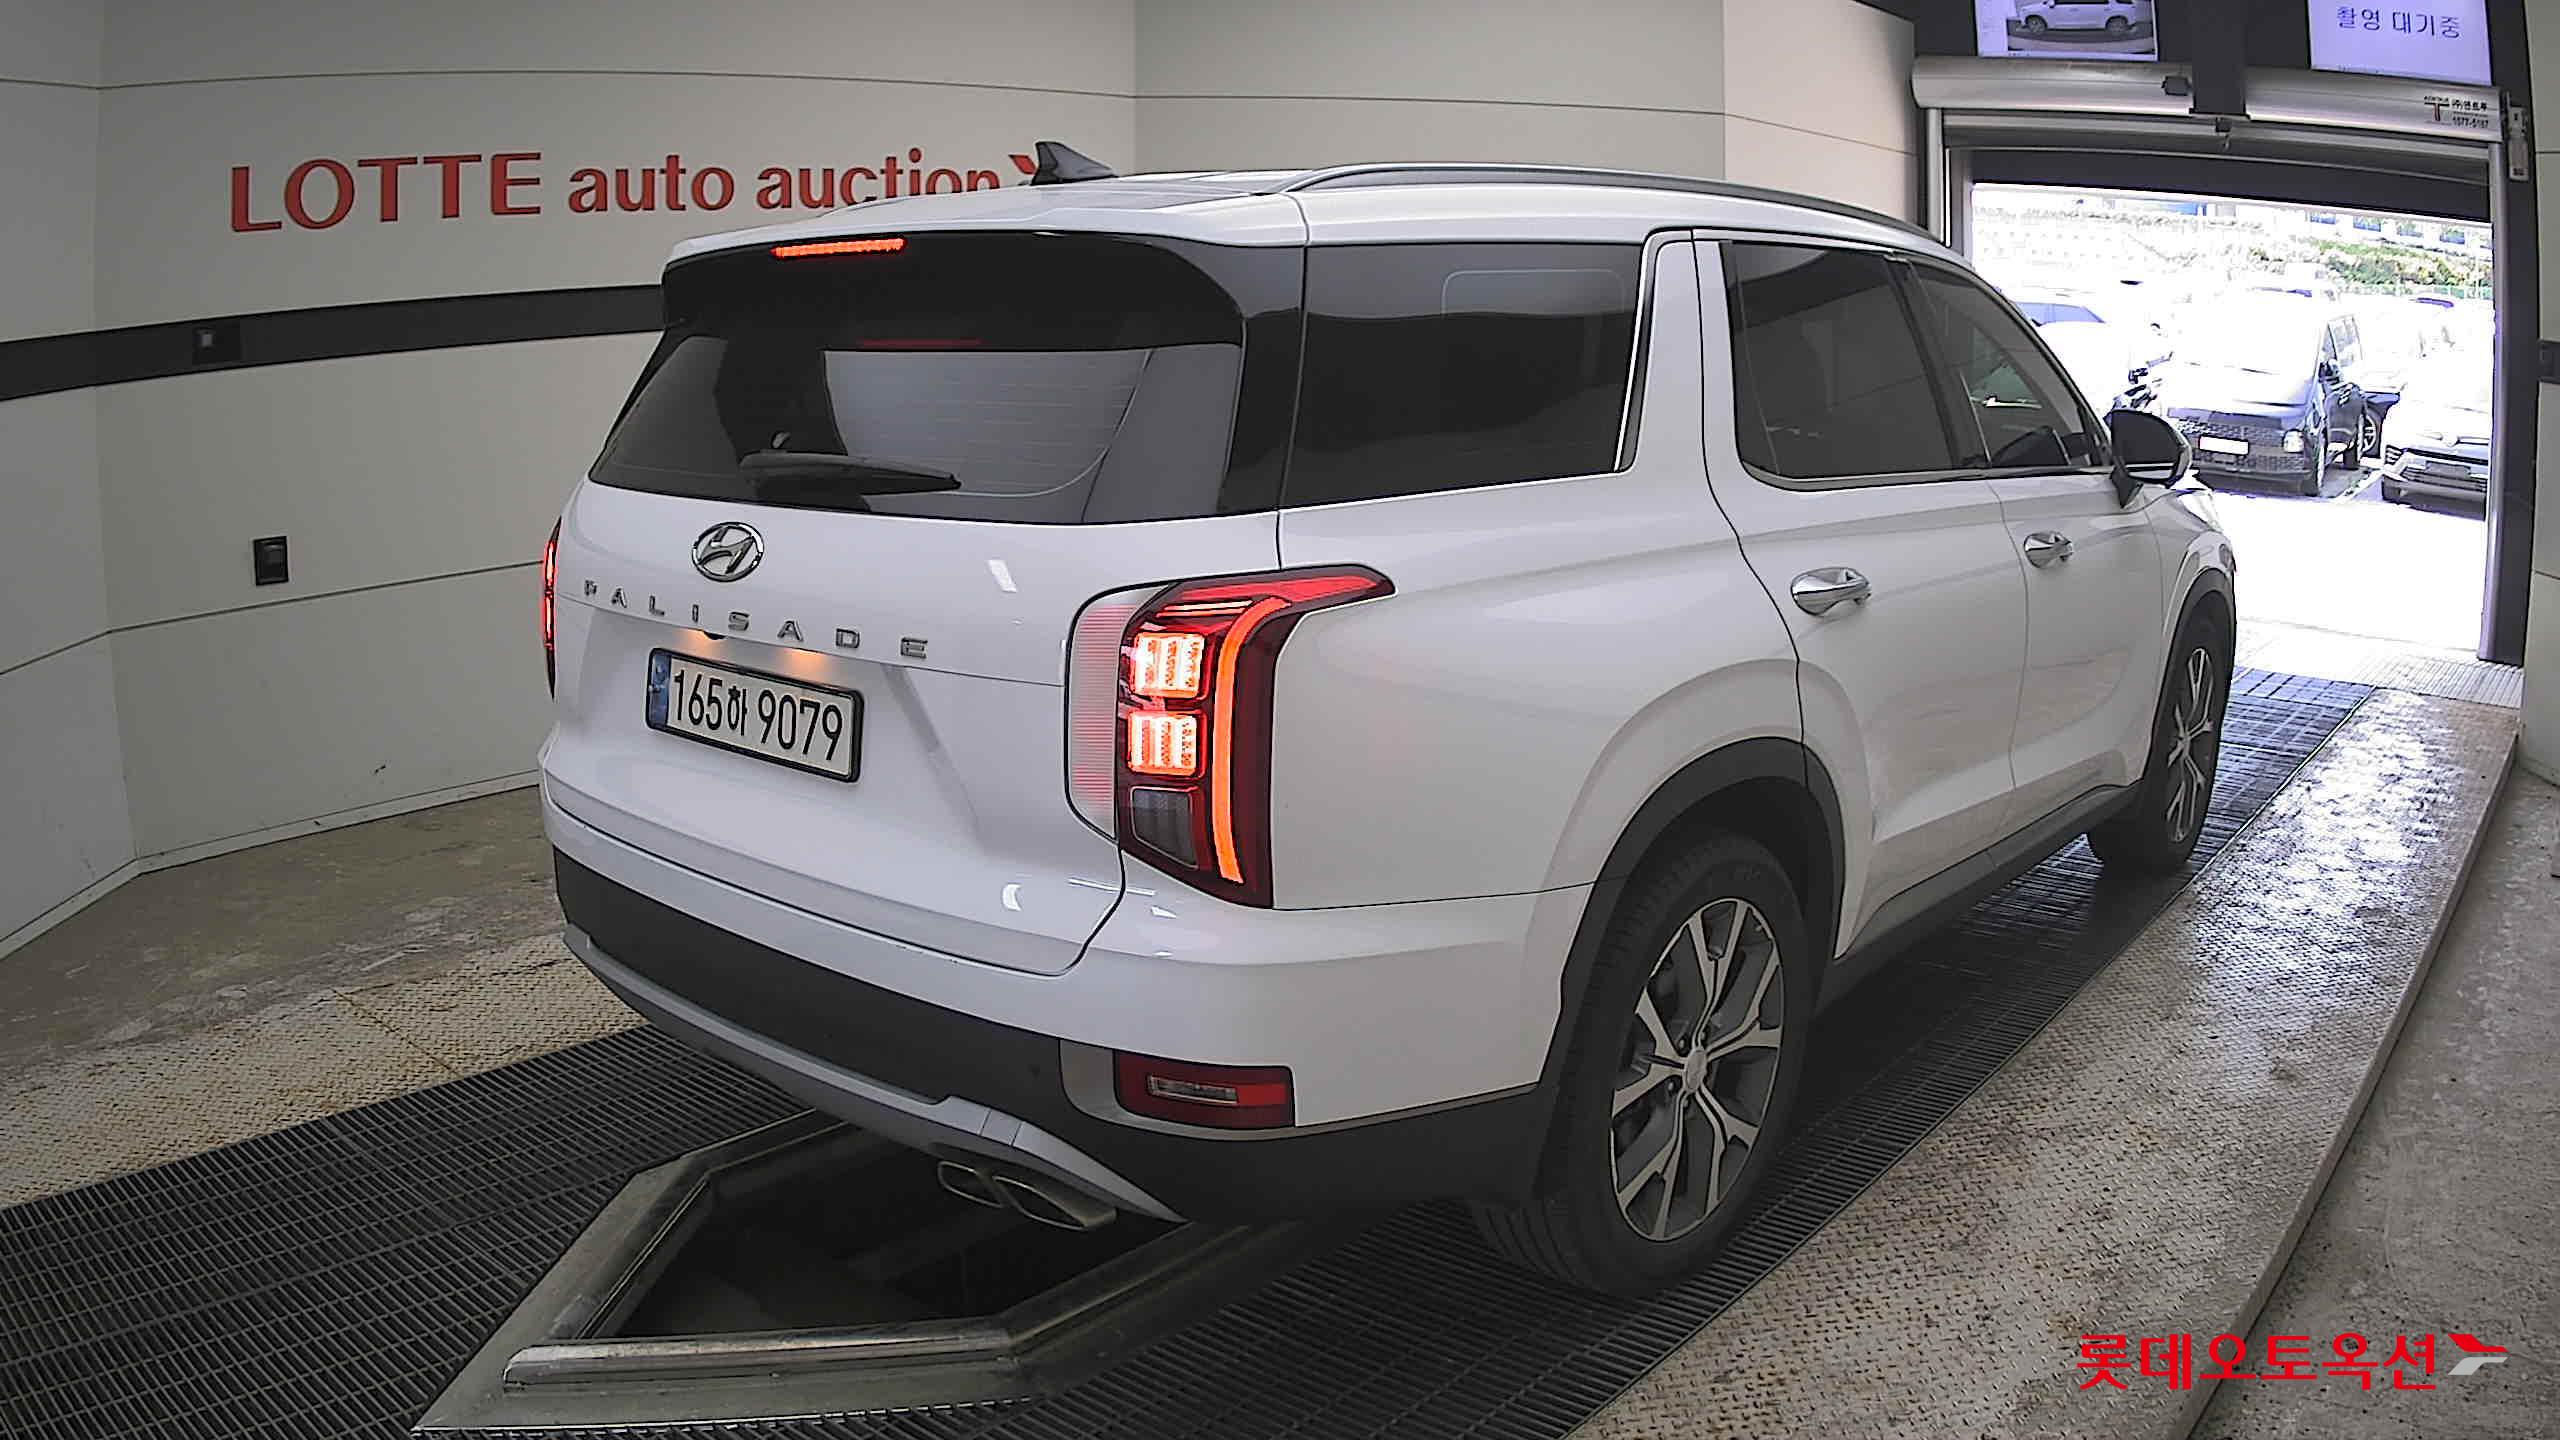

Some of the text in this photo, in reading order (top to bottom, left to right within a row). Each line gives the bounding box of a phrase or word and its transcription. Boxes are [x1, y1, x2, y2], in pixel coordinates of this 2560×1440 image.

[2337, 7, 2460, 39] 촬영 대기중
[231, 147, 1001, 232] LOTTE auto auction
[584, 580, 928, 659] PALISADE
[673, 669, 843, 761] 165하 9079
